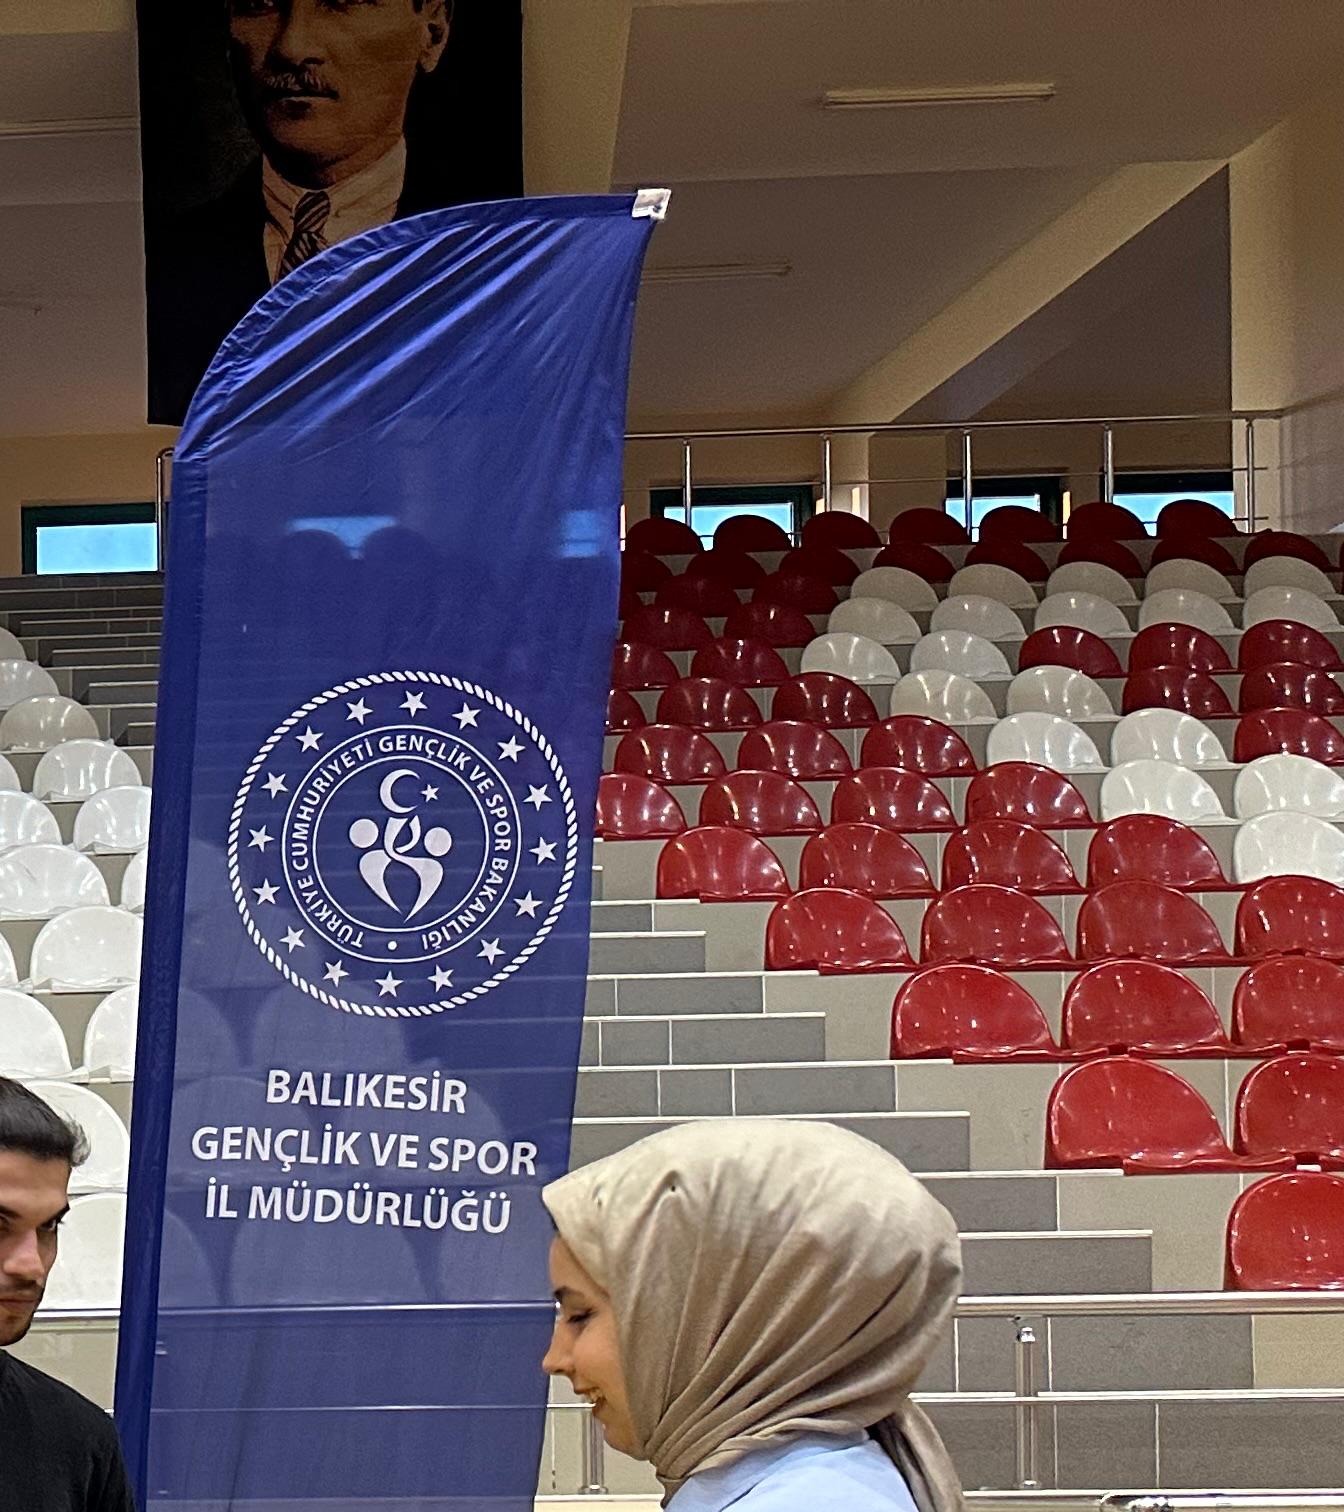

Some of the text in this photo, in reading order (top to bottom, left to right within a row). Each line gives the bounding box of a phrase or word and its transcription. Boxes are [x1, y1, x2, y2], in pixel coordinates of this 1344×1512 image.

[291, 735, 511, 951] TÜRKİYE CUMHURİYETİ GENÇLİK VE SPOR BAKANLIĞI
[267, 1069, 467, 1114] BALIKESİR
[191, 1124, 538, 1175] GENÇLİK VE SPOR
[205, 1177, 511, 1233] İL MÜDÜRLÜĞÜ
